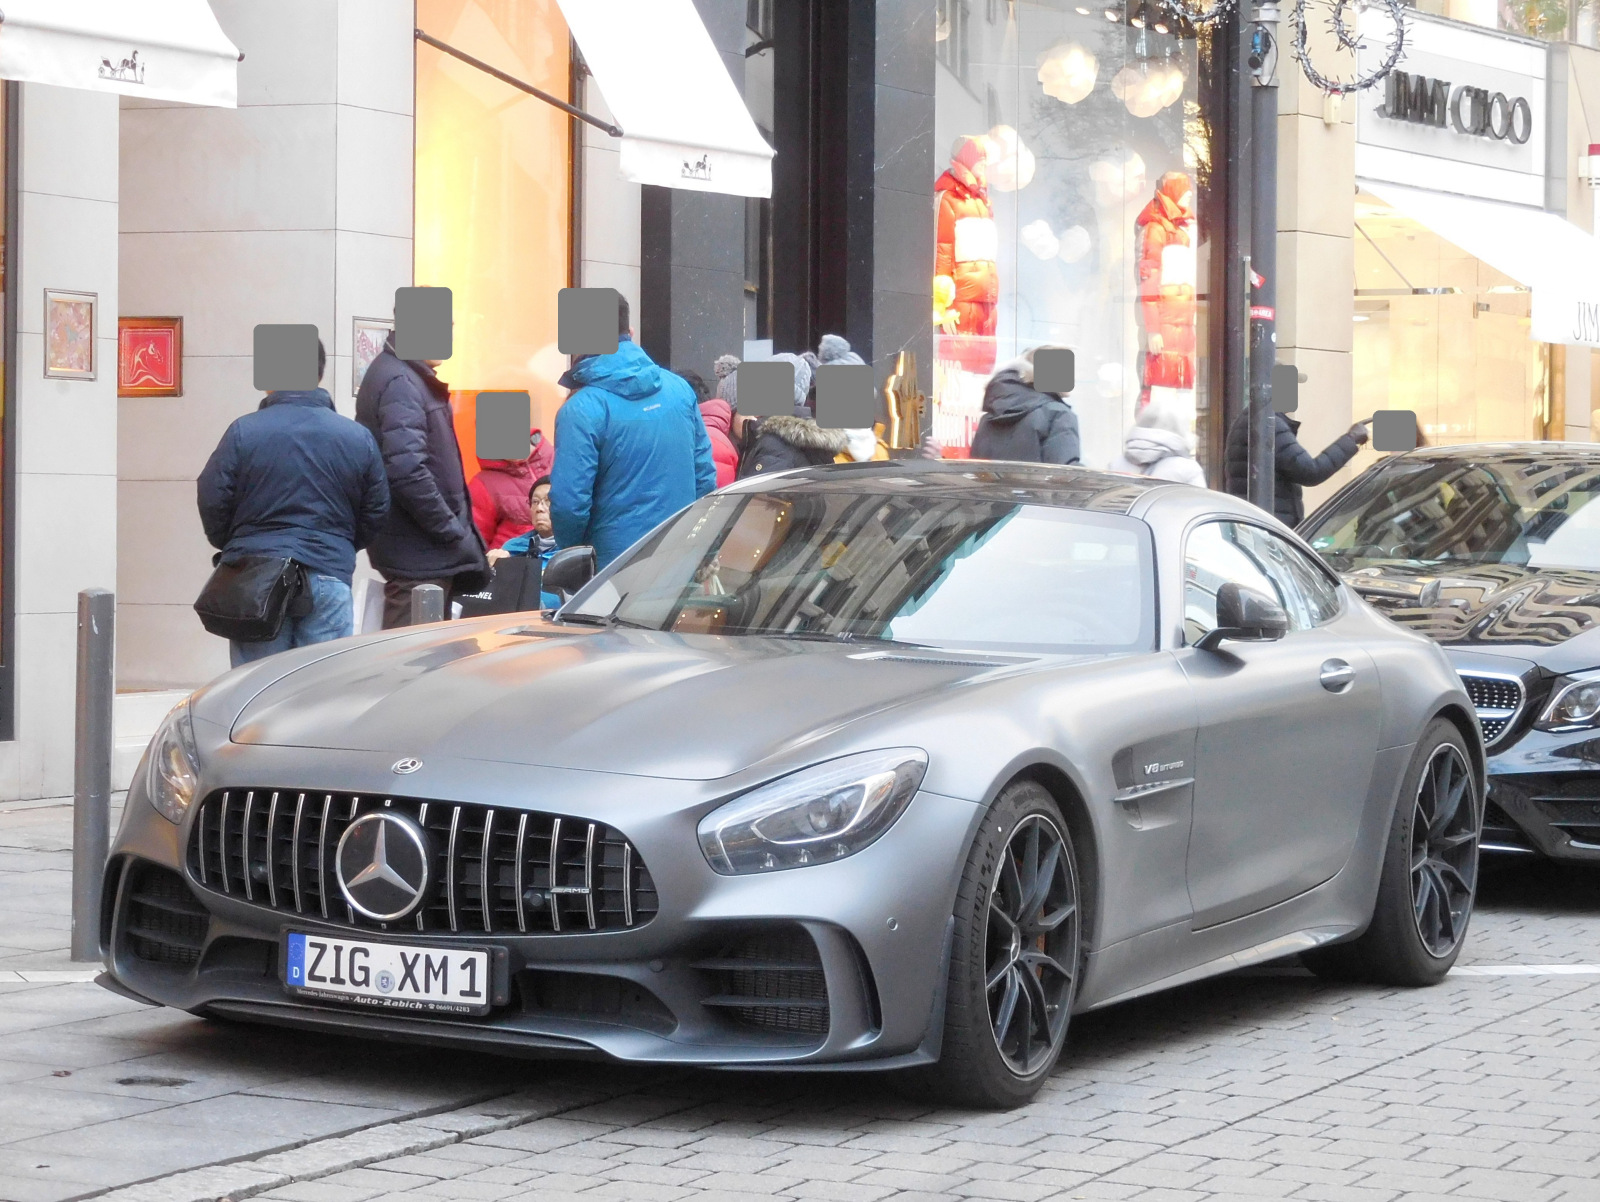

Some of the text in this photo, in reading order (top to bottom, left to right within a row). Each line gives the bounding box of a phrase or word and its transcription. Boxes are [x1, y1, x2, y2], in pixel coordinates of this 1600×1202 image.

[1376, 69, 1532, 145] JIMMY CHOO
[1144, 763, 1159, 775] V8
[292, 966, 300, 978] D
[307, 941, 371, 987] ZIG
